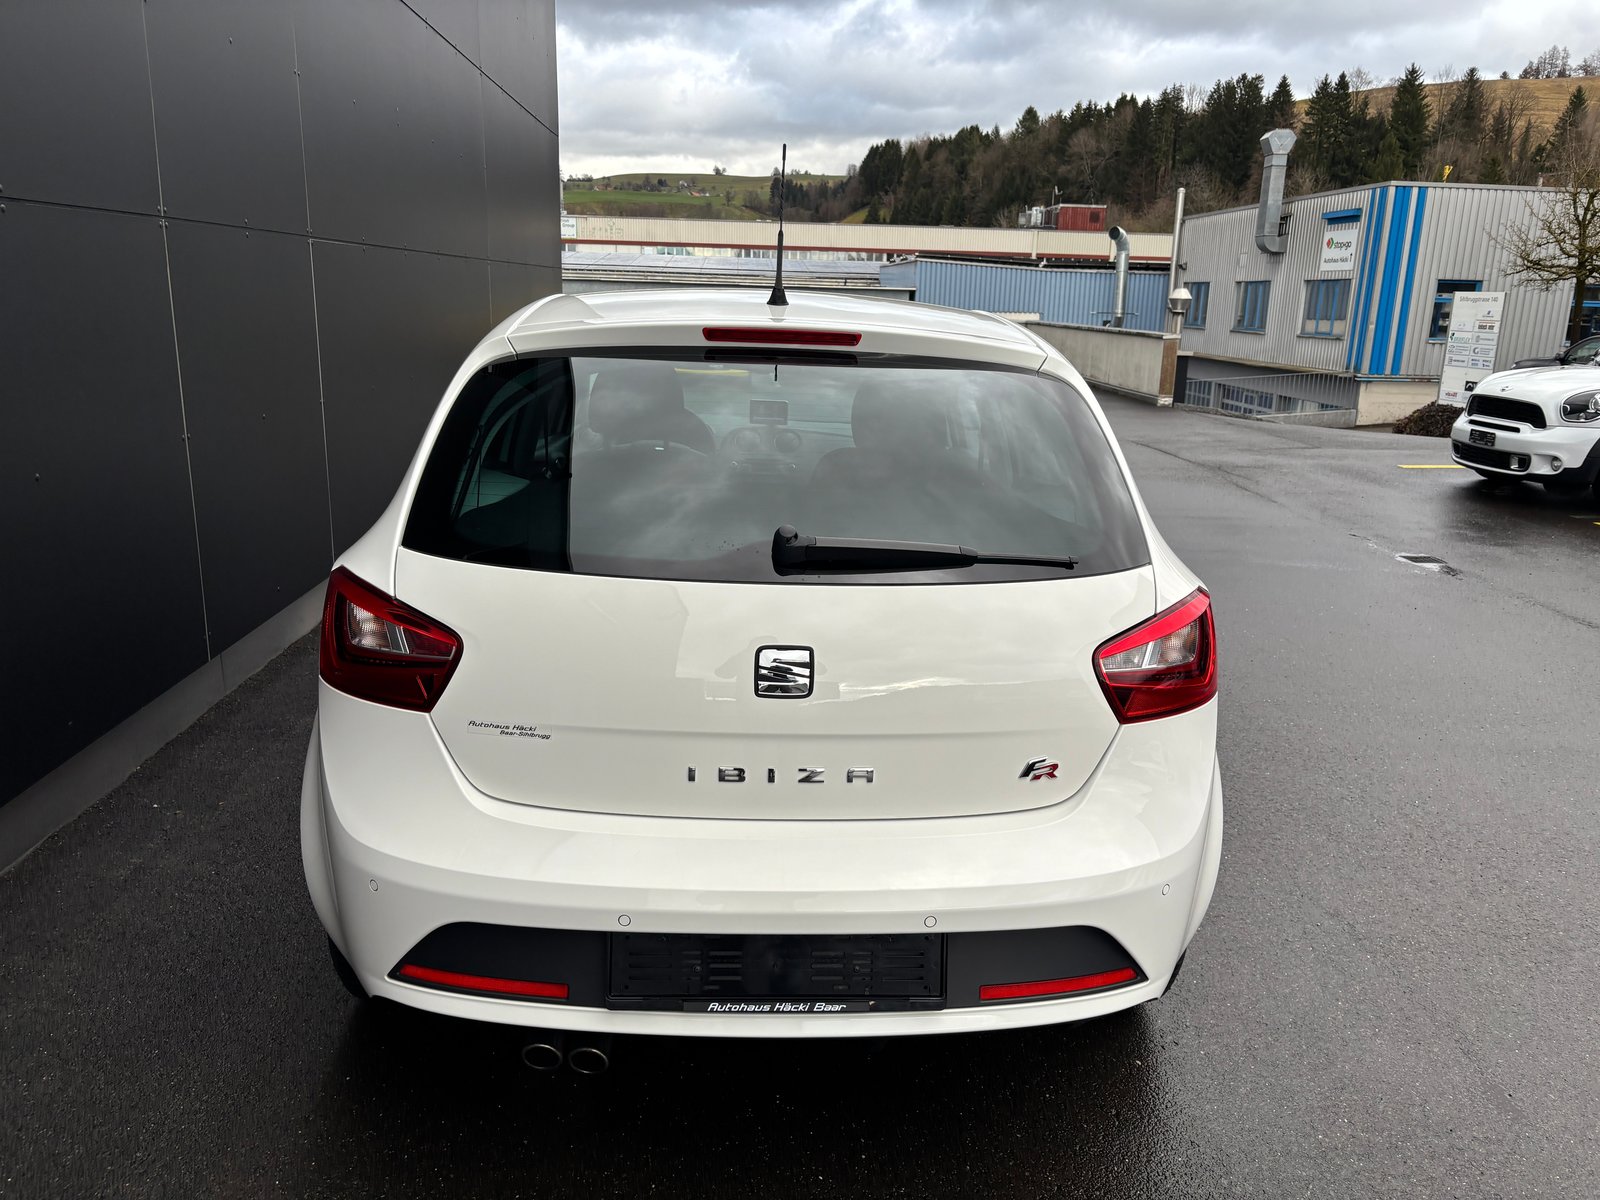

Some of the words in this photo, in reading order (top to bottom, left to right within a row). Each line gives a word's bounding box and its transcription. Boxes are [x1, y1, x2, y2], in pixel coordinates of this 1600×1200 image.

[468, 720, 510, 730] Autohaus
[512, 724, 537, 732] Häcki
[499, 730, 551, 740] Baar-Sihlbrugg
[1018, 756, 1058, 781] FR
[688, 766, 874, 784] IBIZA
[707, 1002, 771, 1012] Autohaus
[773, 1002, 810, 1012] Häcki
[813, 1002, 847, 1012] Baar
